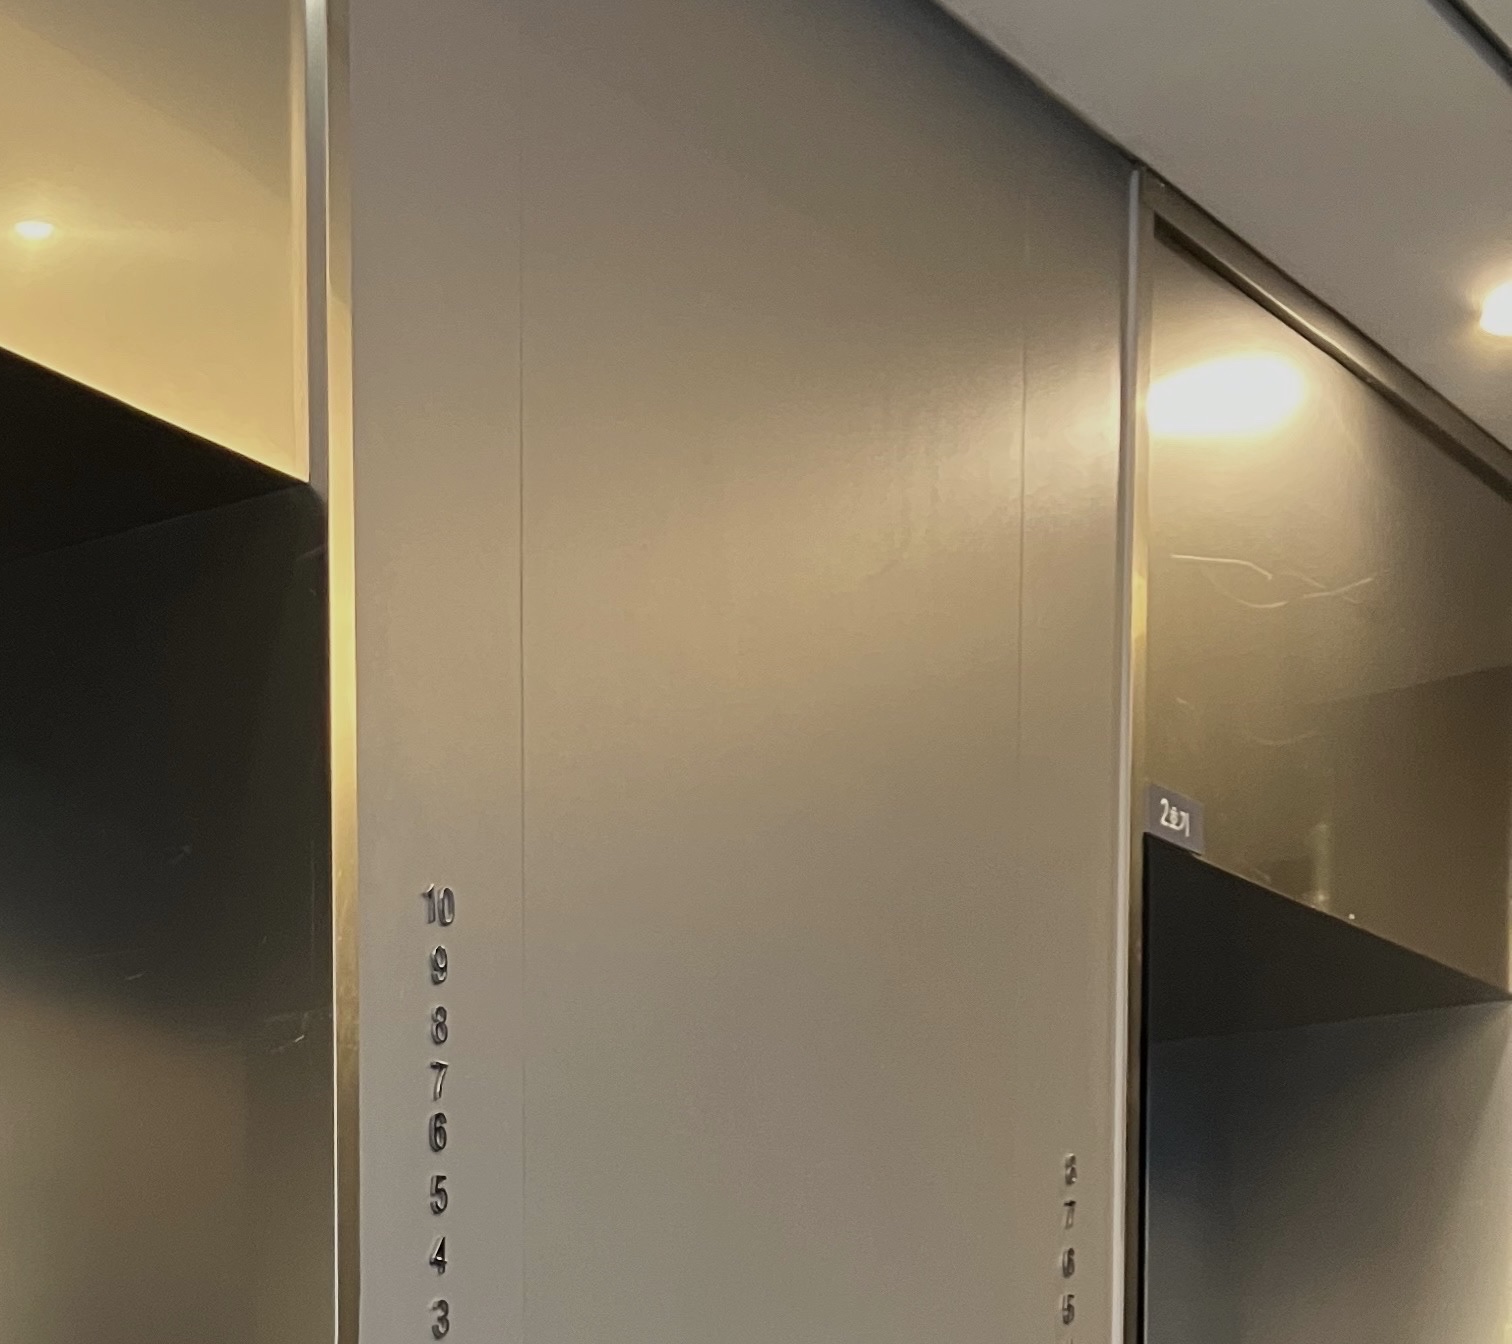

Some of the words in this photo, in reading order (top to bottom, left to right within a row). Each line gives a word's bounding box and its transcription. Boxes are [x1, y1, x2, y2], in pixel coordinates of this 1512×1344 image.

[422, 883, 456, 927] 10
[429, 945, 449, 985] 9
[430, 1006, 449, 1046] 8
[429, 1060, 449, 1102] 7
[429, 1112, 448, 1153] 6
[429, 1175, 449, 1215] 5
[1063, 1200, 1076, 1230] 7
[429, 1236, 448, 1276] 4
[1061, 1247, 1075, 1279] 6
[430, 1299, 450, 1340] 3
[1061, 1294, 1075, 1325] 5
